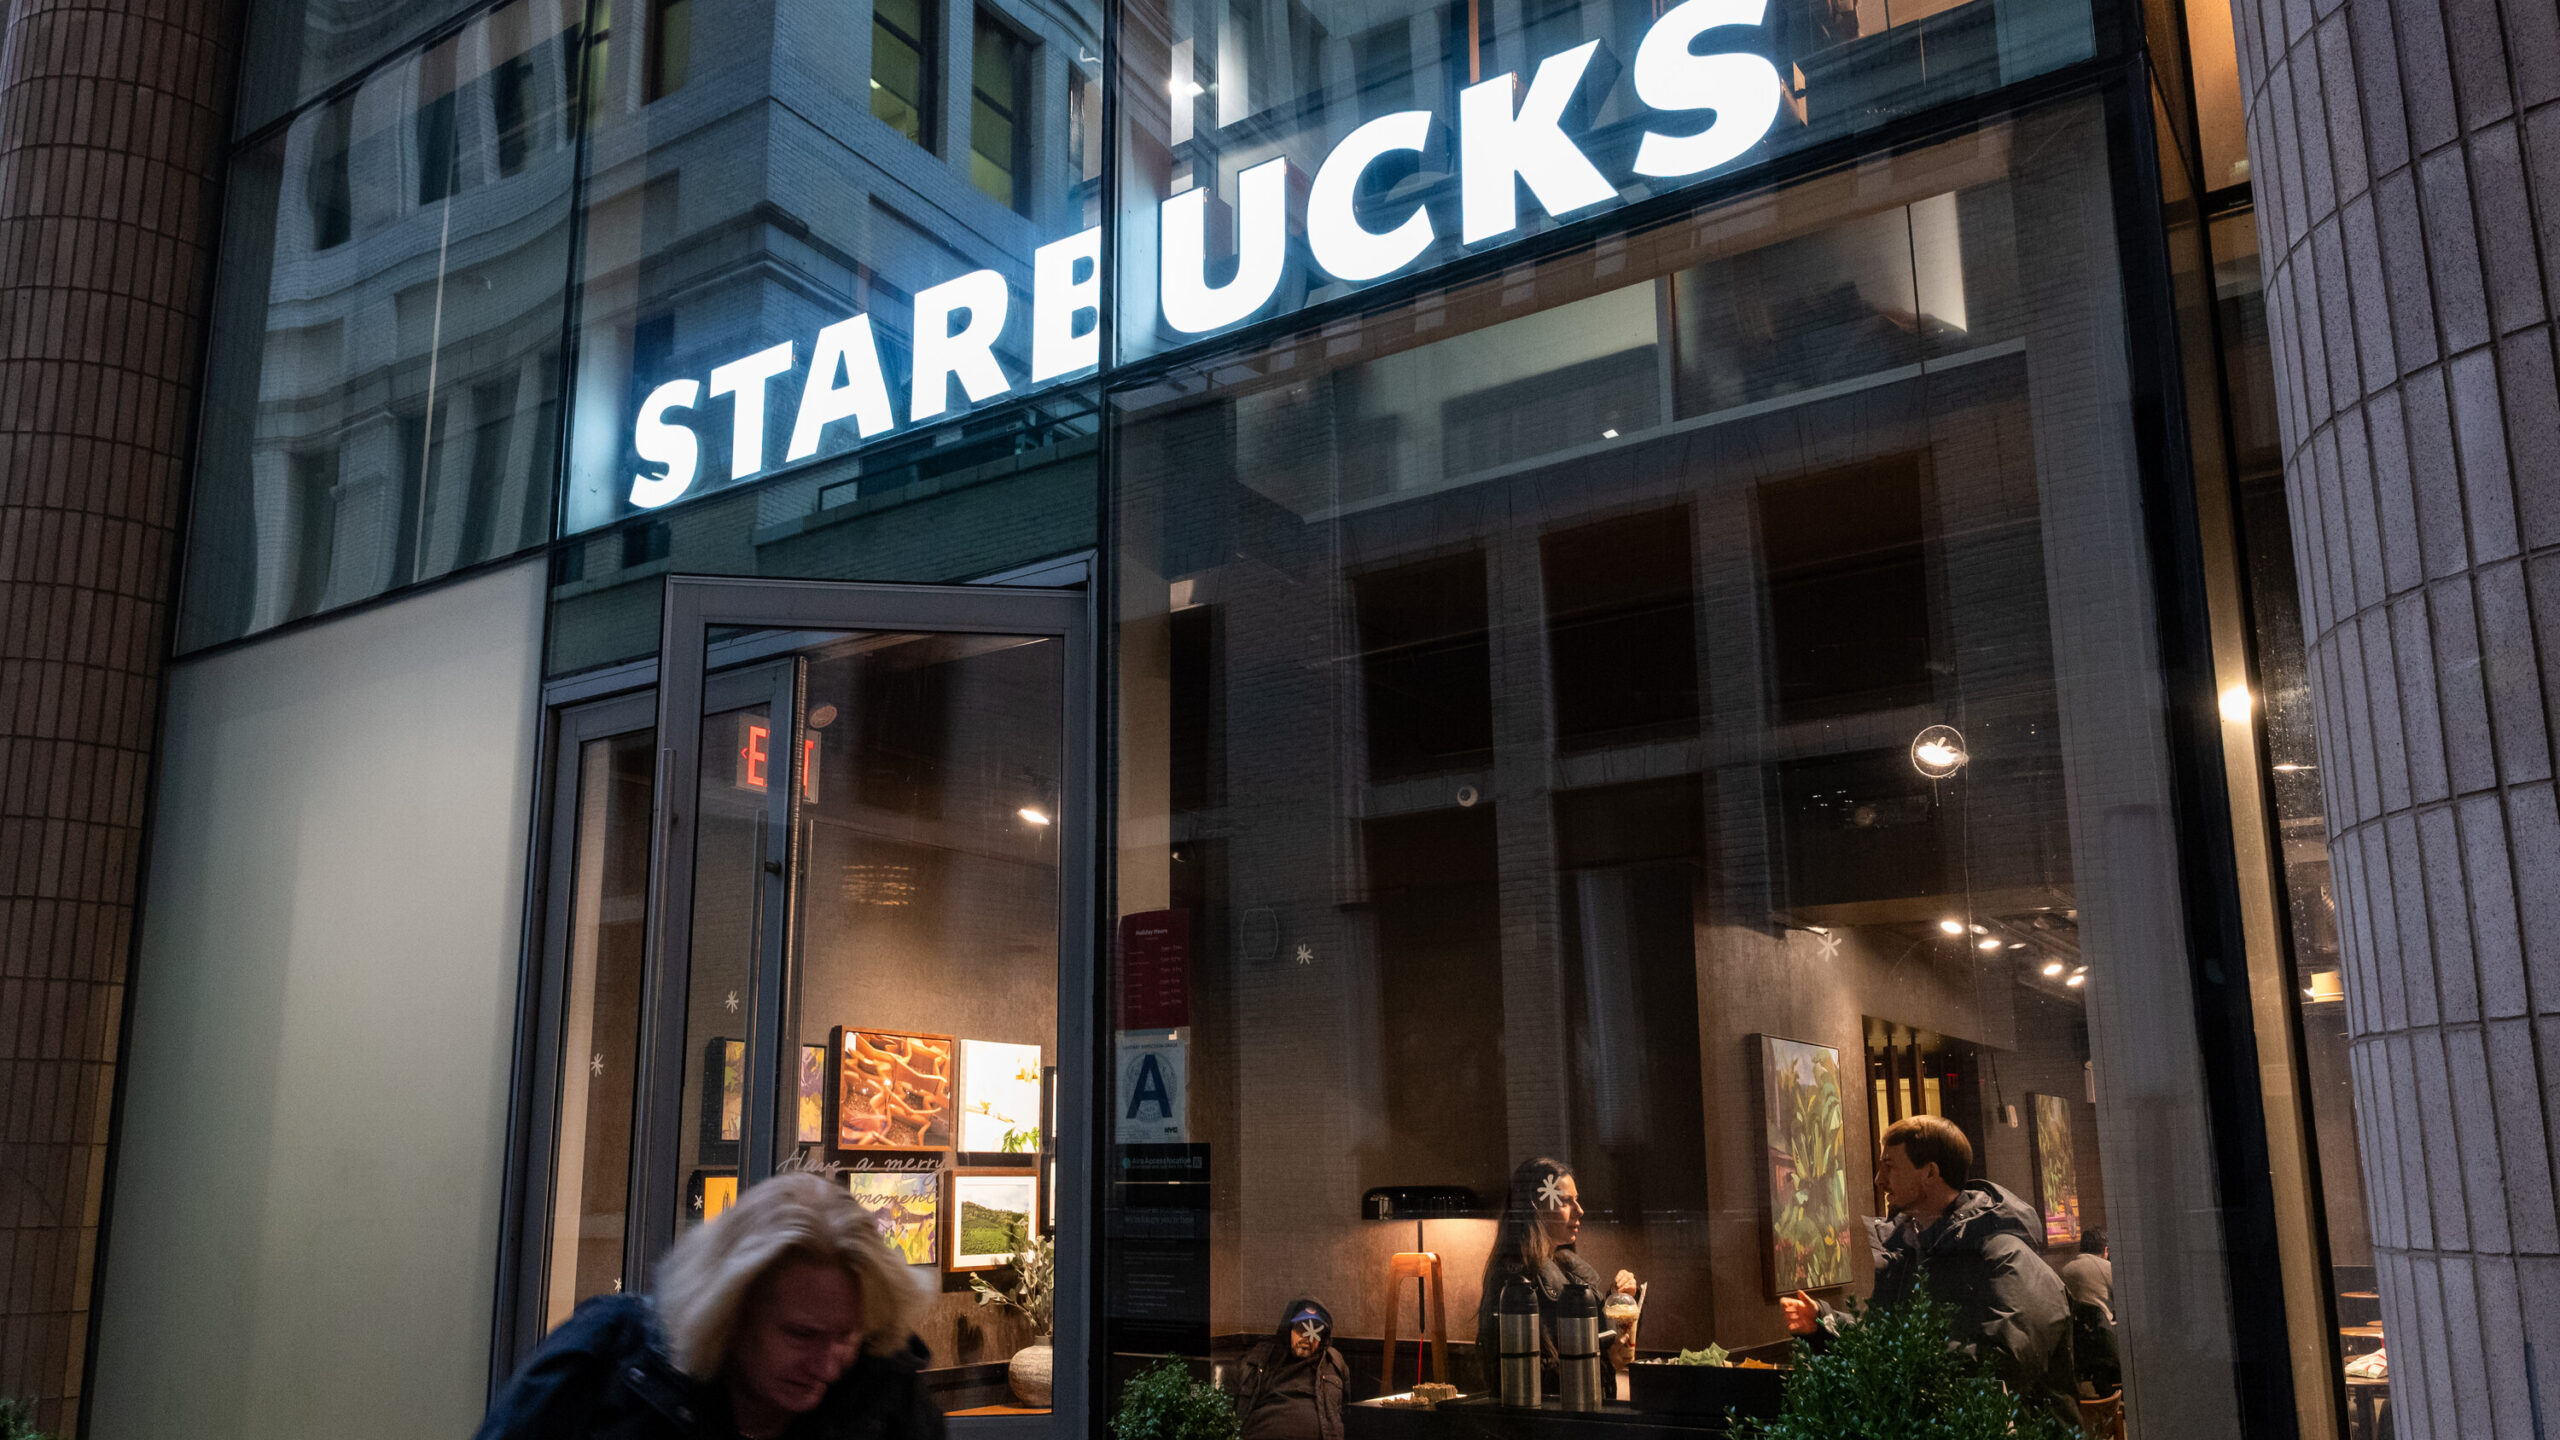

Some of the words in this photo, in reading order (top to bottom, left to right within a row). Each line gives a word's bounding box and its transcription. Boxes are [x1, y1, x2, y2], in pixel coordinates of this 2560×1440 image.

[628, 0, 1783, 511] STARBUCKS
[747, 725, 815, 796] ET
[1126, 1054, 1173, 1119] A
[776, 1148, 845, 1174] Have
[855, 1156, 874, 1172] a
[883, 1156, 948, 1188] merry
[854, 1188, 942, 1206] moment
